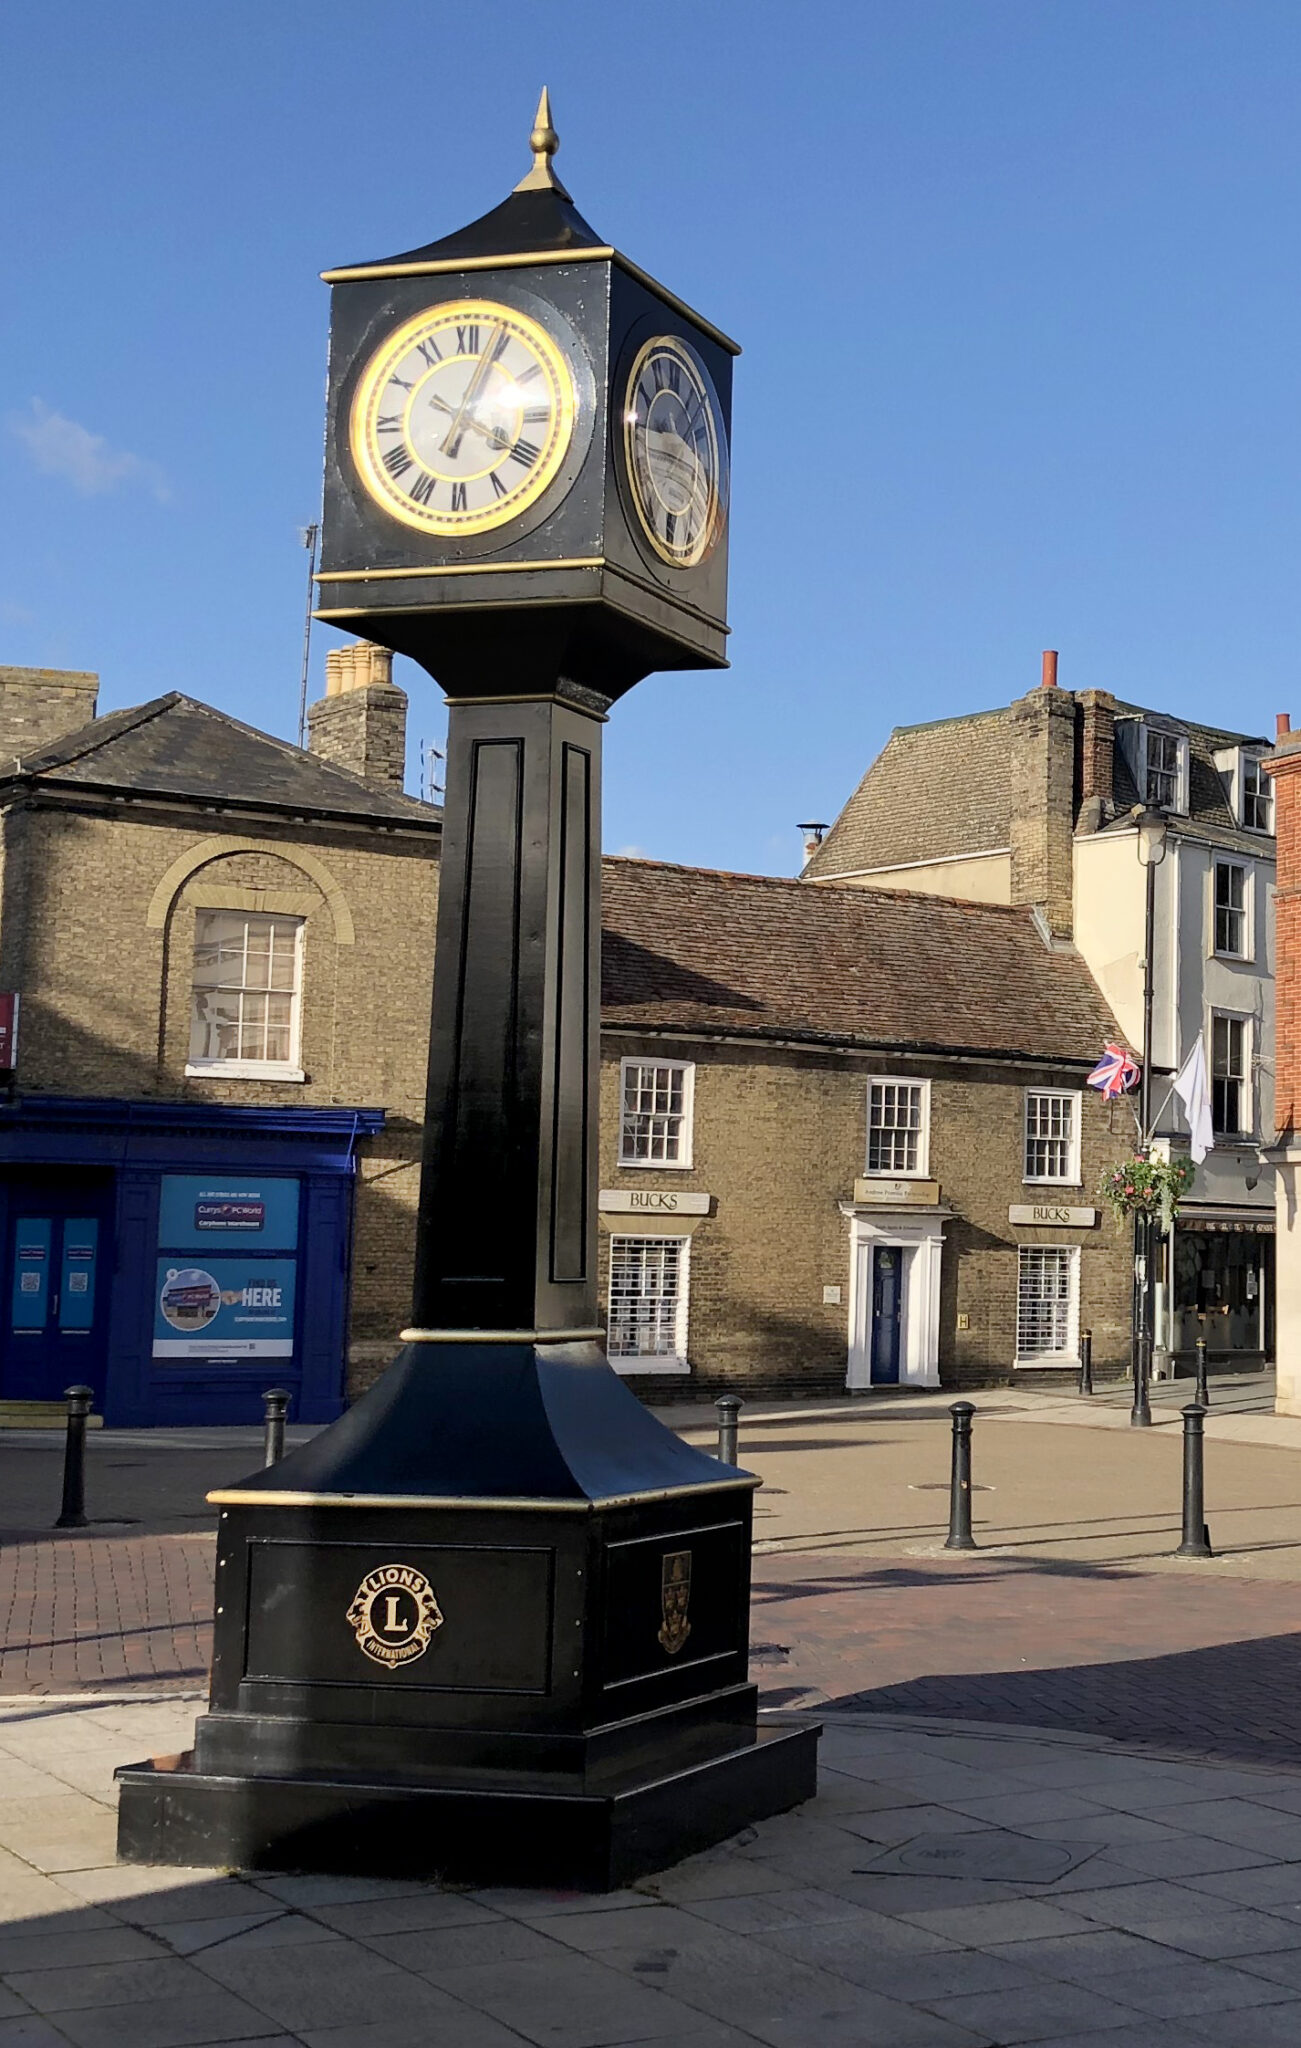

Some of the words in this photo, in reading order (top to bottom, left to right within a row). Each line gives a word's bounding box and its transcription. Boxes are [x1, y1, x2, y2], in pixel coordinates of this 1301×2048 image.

[198, 1205, 221, 1215] Currys
[630, 1192, 678, 1211] BUCKS
[1033, 1206, 1070, 1223] BUCKS
[241, 1287, 282, 1307] HERE
[368, 1568, 424, 1592] LIONS
[383, 1596, 409, 1632] L
[366, 1639, 420, 1660] INTERNATIONAL
